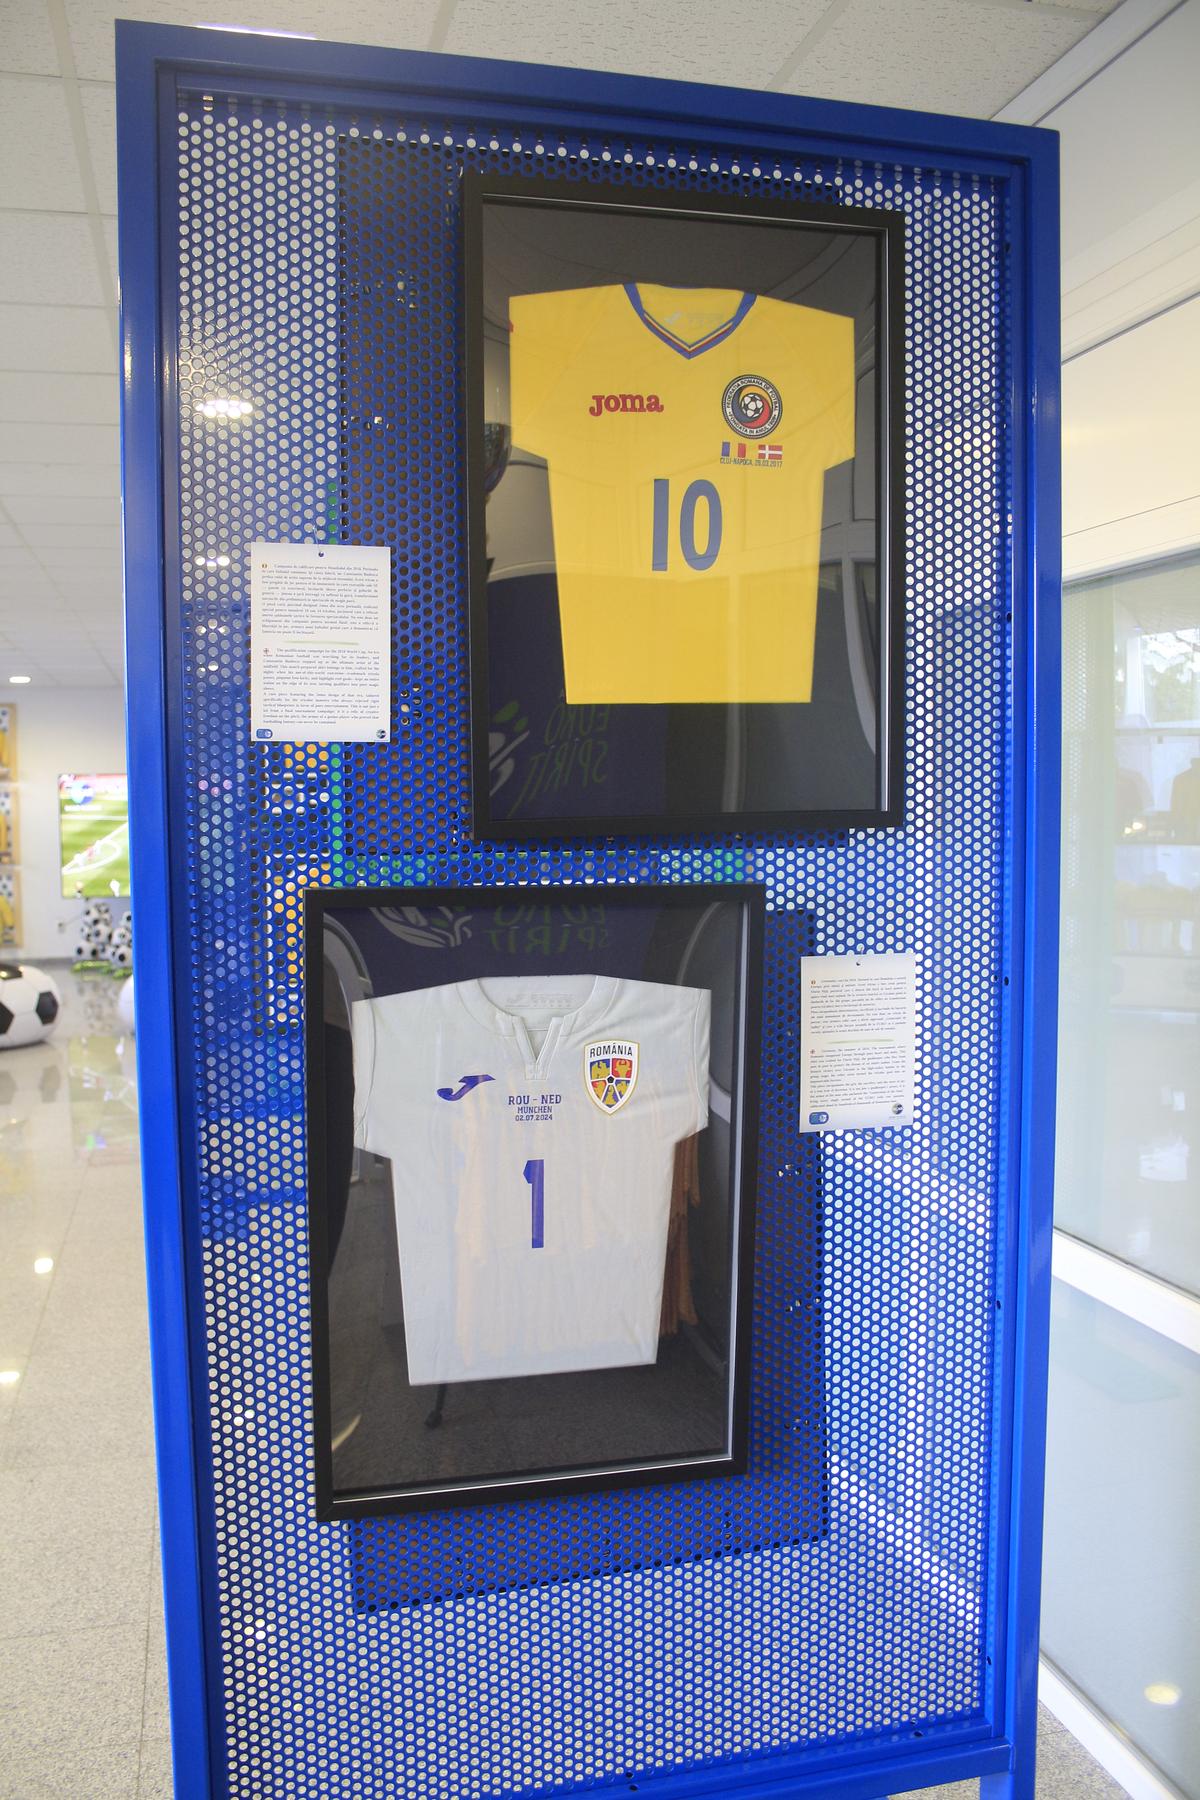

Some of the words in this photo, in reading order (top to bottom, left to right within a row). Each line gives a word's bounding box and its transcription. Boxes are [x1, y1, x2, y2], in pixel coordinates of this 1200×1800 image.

[652, 478, 723, 572] 10
[508, 1096, 530, 1105] ROU
[541, 1094, 562, 1104] NED
[515, 1114, 553, 1122] 02.07.2024
[523, 1159, 544, 1248] 1
